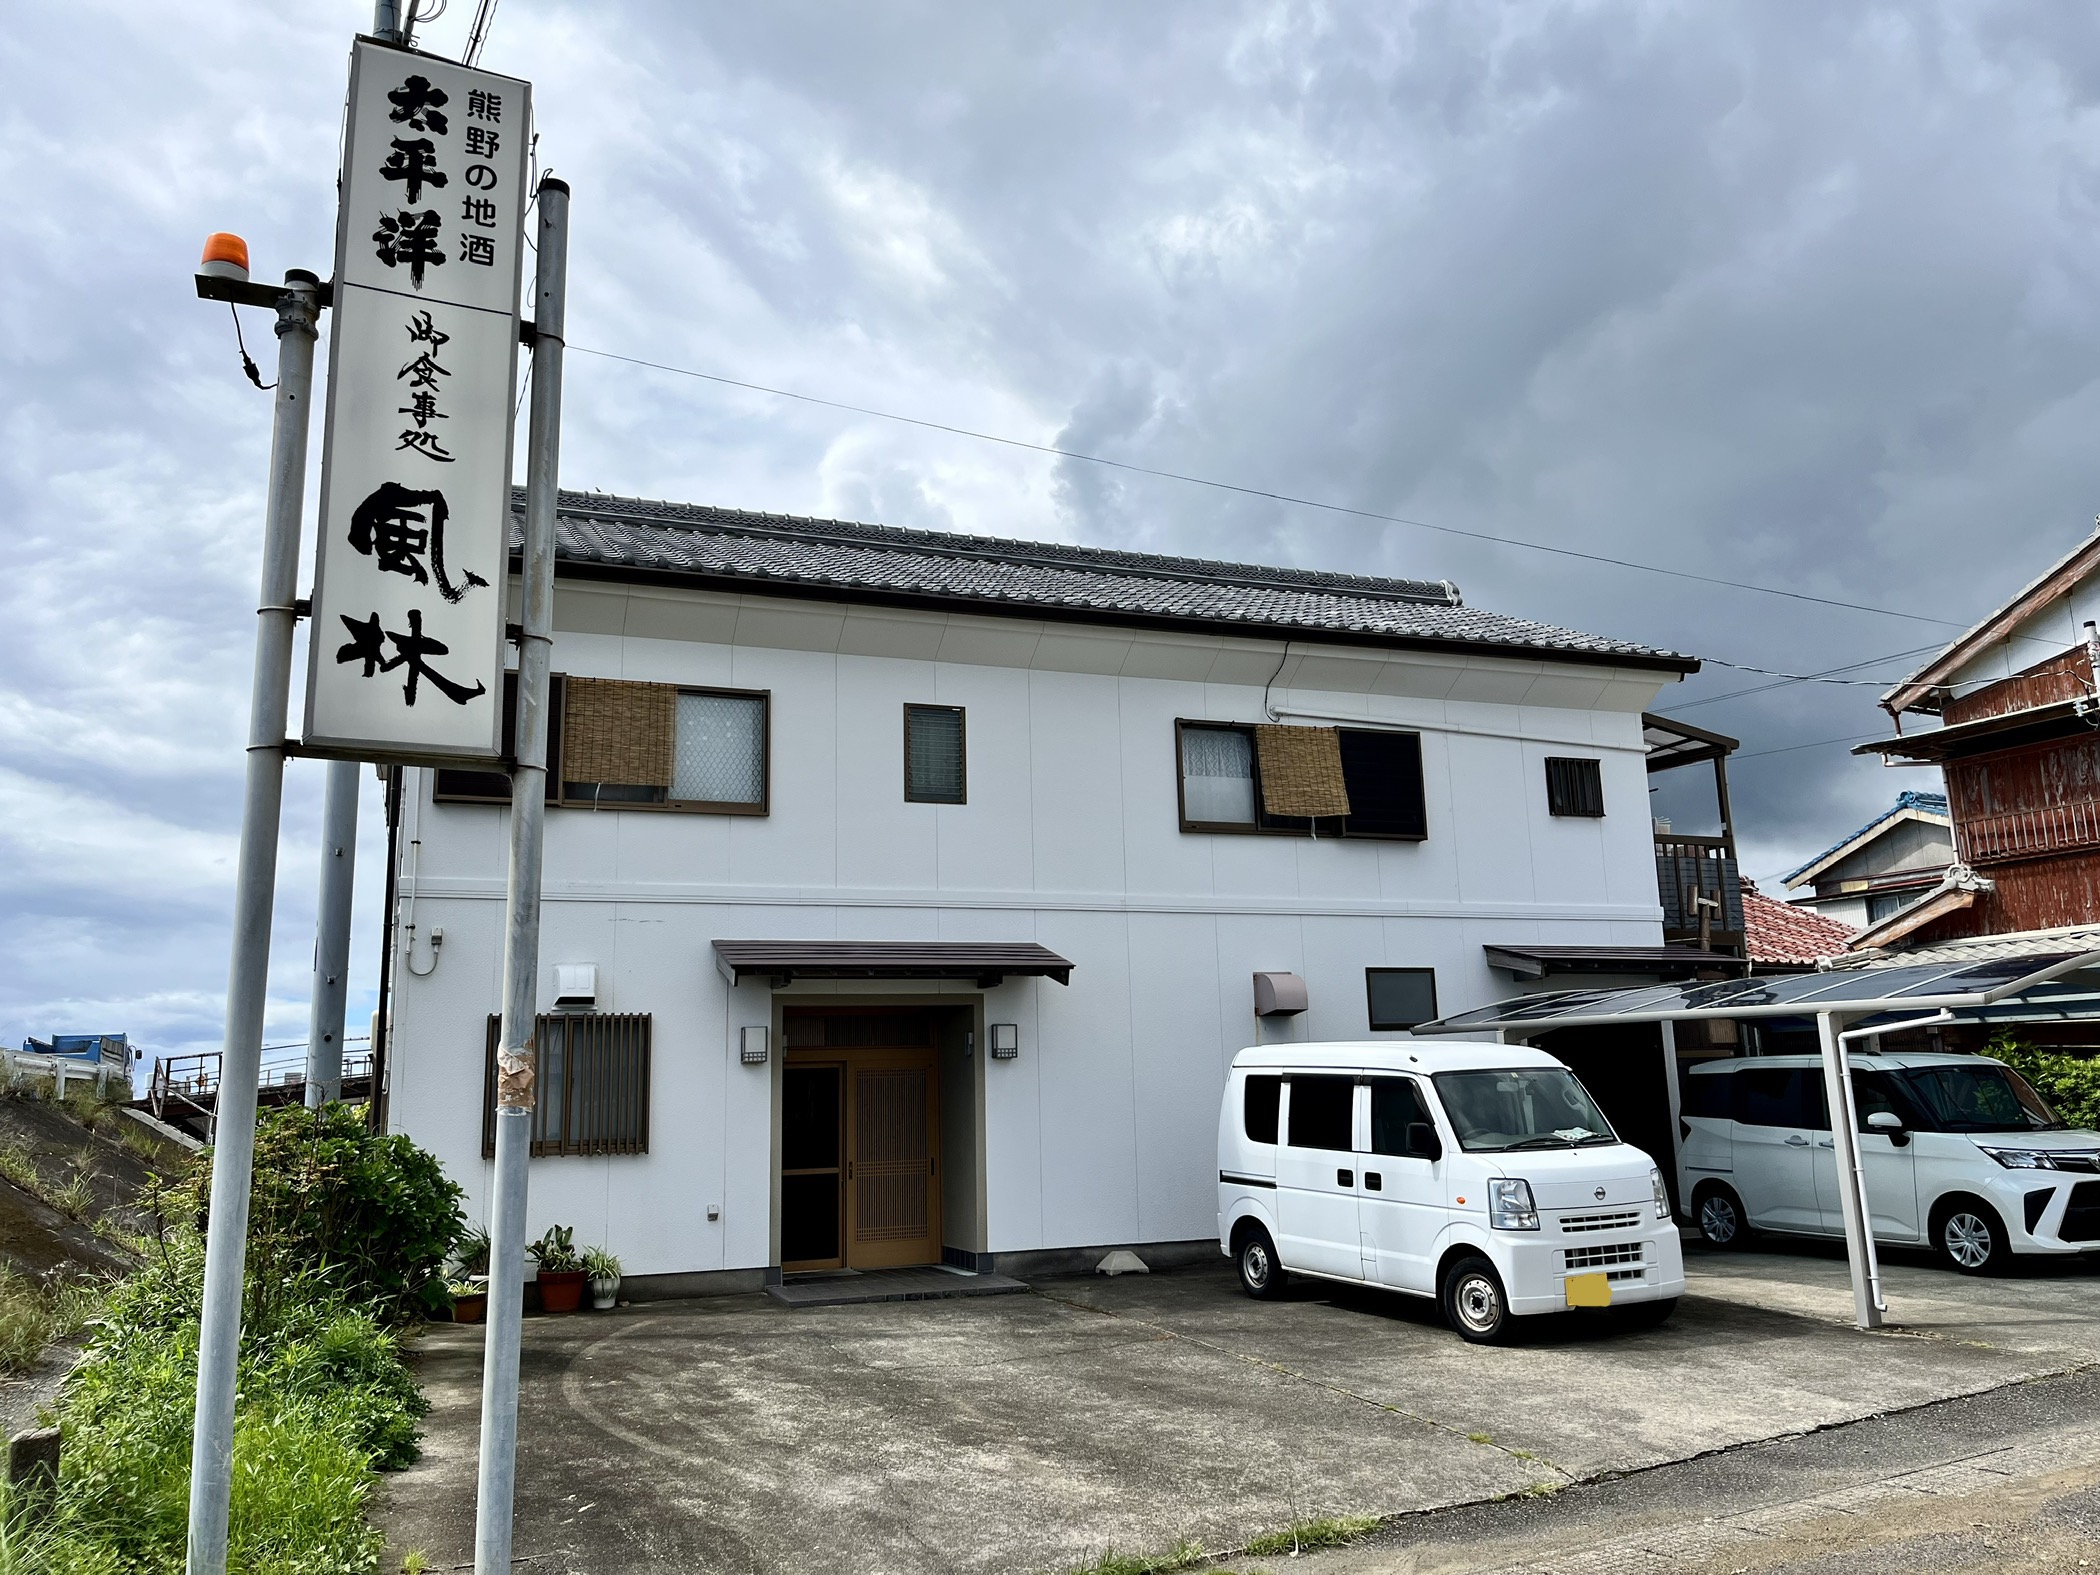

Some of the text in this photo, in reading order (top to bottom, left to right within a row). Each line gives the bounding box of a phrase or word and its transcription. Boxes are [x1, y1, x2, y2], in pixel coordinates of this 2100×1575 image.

[372, 75, 449, 291] 太平洋
[459, 89, 502, 266] 熊野の地酒
[394, 310, 456, 462] 御食事処
[336, 482, 490, 707] 風林
